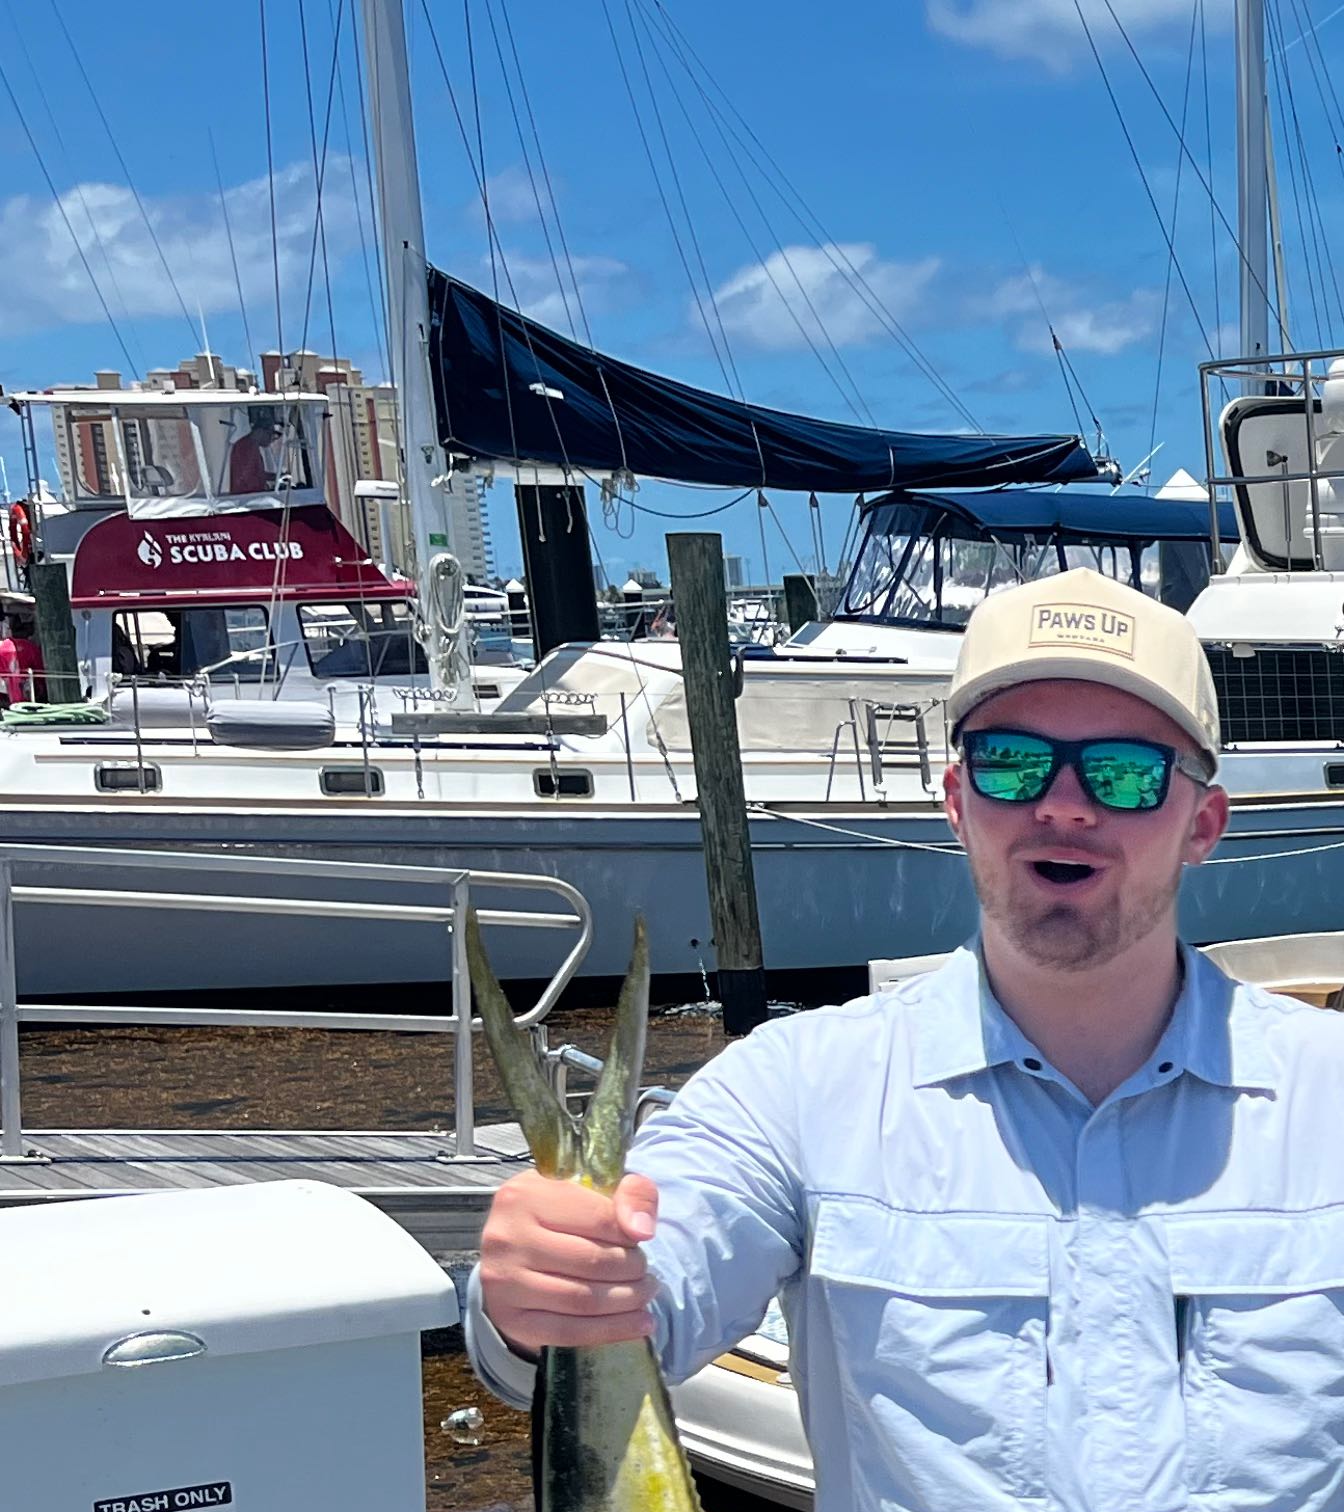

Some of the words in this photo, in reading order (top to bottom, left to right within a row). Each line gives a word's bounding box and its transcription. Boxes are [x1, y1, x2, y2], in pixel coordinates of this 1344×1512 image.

[165, 534, 188, 544] THE
[170, 543, 247, 564] SCUBA
[249, 542, 304, 560] CLUB
[1038, 609, 1096, 631] PAWS
[1101, 612, 1129, 637] UP
[174, 1486, 227, 1507] ONLY
